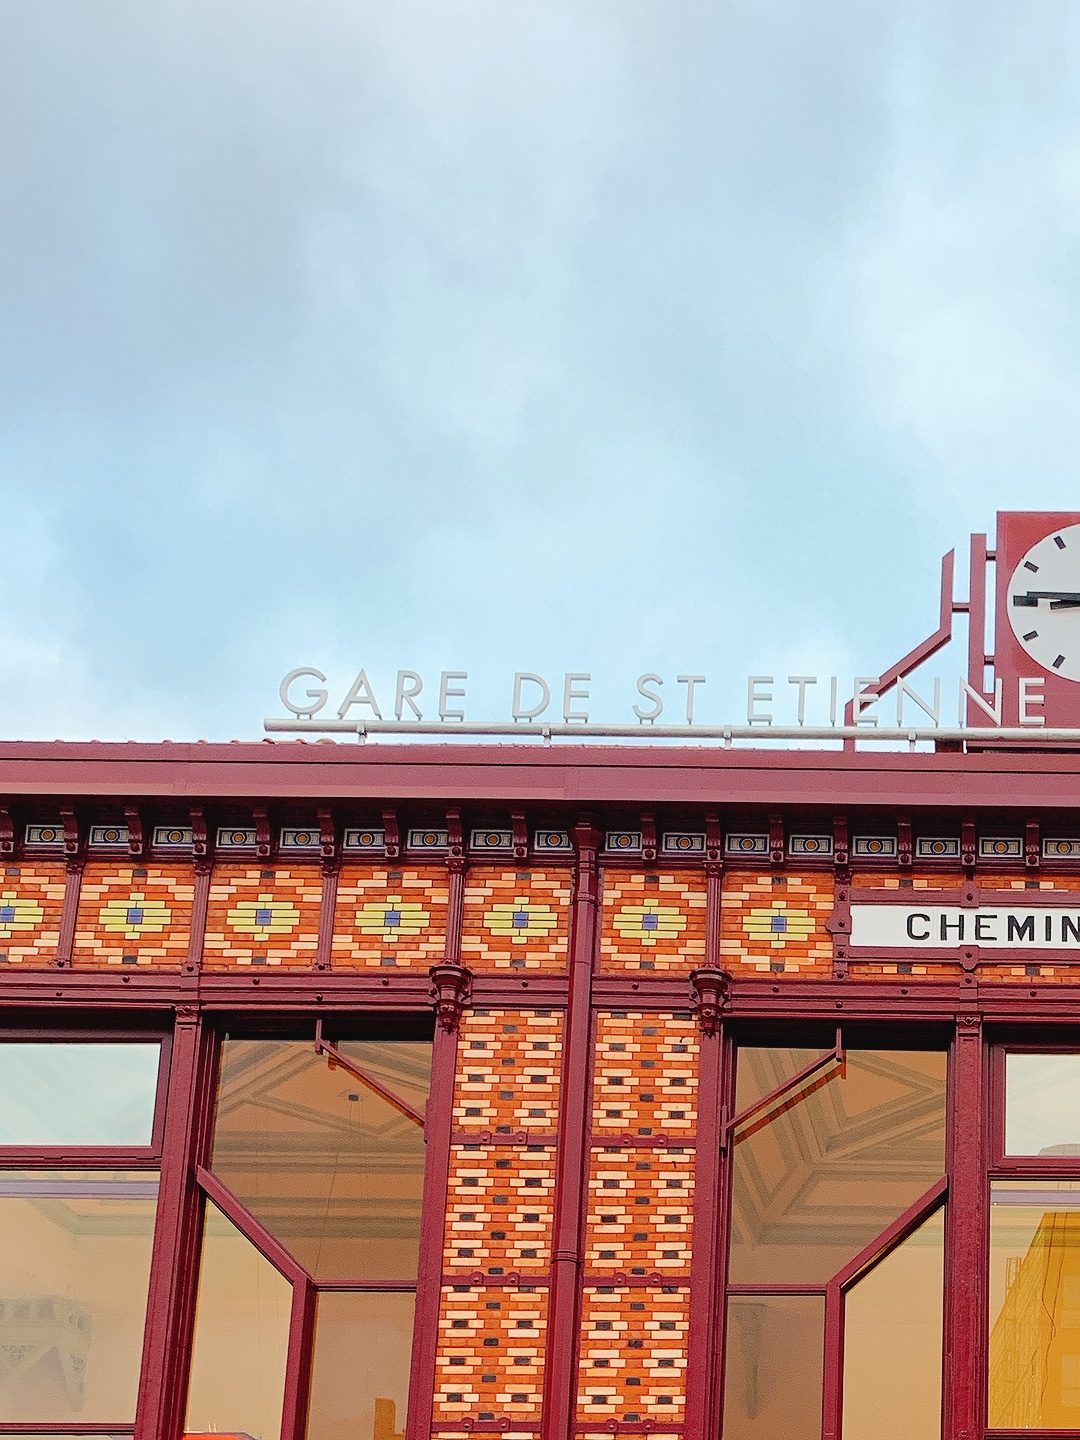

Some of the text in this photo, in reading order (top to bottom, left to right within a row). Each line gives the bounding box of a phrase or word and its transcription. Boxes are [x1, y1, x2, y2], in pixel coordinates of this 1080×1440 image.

[279, 667, 468, 719] GARE
[513, 671, 592, 722] DE
[633, 673, 706, 723] ST
[747, 676, 1046, 726] ETIENNE
